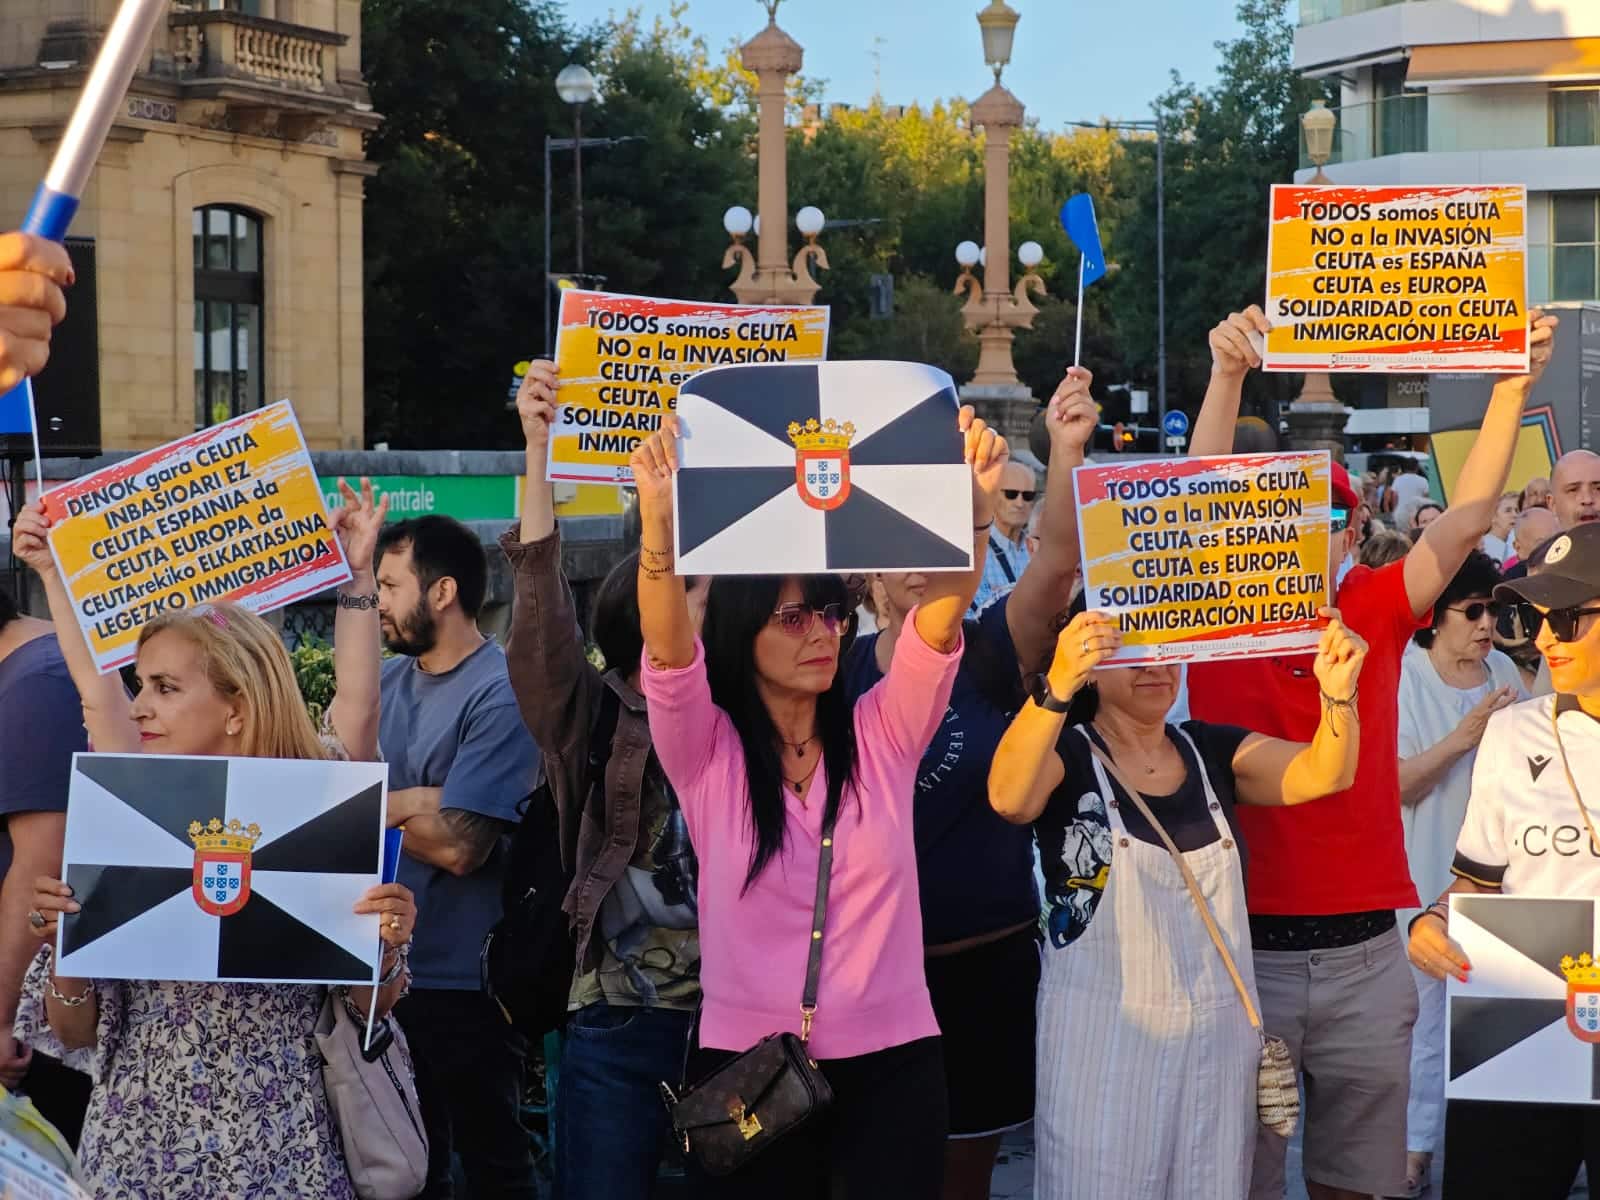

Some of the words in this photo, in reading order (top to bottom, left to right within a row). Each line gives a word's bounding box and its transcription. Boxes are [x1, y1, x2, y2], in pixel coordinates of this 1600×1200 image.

[1301, 203, 1371, 221] TODOS
[1378, 207, 1439, 221] somos
[1445, 202, 1500, 220] CEUTA
[1311, 228, 1344, 246] NO
[1351, 233, 1362, 246] a
[1371, 227, 1388, 246] la
[1396, 222, 1491, 245] INVASIÓN
[1315, 252, 1376, 270] CEUTA
[1382, 257, 1403, 270] es
[1410, 247, 1487, 269] ESPAÑA
[1313, 276, 1374, 294] CEUTA
[1380, 281, 1400, 294] es
[1408, 275, 1487, 293] EUROPA
[1278, 299, 1412, 317] SOLIDARIDAD
[1419, 304, 1452, 317] con
[1459, 299, 1518, 317] CEUTA
[588, 310, 659, 334] TODOS
[666, 323, 730, 340] somos
[737, 323, 797, 341] CEUTA
[1294, 319, 1436, 341] INMIGRACIÓN
[1442, 323, 1501, 341] LEGAL
[597, 338, 631, 357] NO
[638, 345, 650, 358] a
[658, 341, 676, 361] la
[683, 342, 786, 363] INVASIÓN
[601, 362, 663, 384] CEUTA
[599, 387, 661, 408] CEUTA
[563, 407, 661, 431] SOLIDARI
[66, 475, 139, 518] DENOK
[146, 461, 191, 492] gara
[196, 433, 258, 468] CEUTA
[1107, 477, 1181, 501] TODOS
[1188, 480, 1250, 495] somos
[1256, 471, 1309, 491] CEUTA
[104, 472, 221, 529] INBASIOARI
[226, 461, 251, 484] EZ
[1122, 506, 1157, 527] NO
[1164, 509, 1177, 523] a
[1184, 502, 1201, 522] la
[1208, 493, 1302, 521] INVASIÓN
[92, 526, 153, 560] CEUTA
[158, 488, 248, 537] ESPAINIA
[253, 479, 279, 500] da
[106, 547, 169, 581] CEUTA
[172, 515, 253, 557] EUROPA
[257, 506, 283, 526] da
[1130, 530, 1192, 552] CEUTA
[1199, 534, 1218, 548] es
[1225, 520, 1298, 546] ESPAÑA
[82, 565, 196, 617] CEUTArekiko
[200, 512, 327, 573] ELKARTASUNA
[1132, 557, 1193, 579] CEUTA
[1199, 561, 1219, 575] es
[1225, 551, 1300, 573] EUROPA
[96, 592, 186, 639] LEGEZKO
[190, 539, 330, 603] IMMIGRAZIOA
[1100, 581, 1231, 607] SOLIDARIDAD
[1237, 584, 1269, 597] con
[1275, 574, 1324, 595] CEUTA
[1119, 600, 1253, 632] INMIGRACIÓN
[1261, 601, 1316, 622] LEGAL
